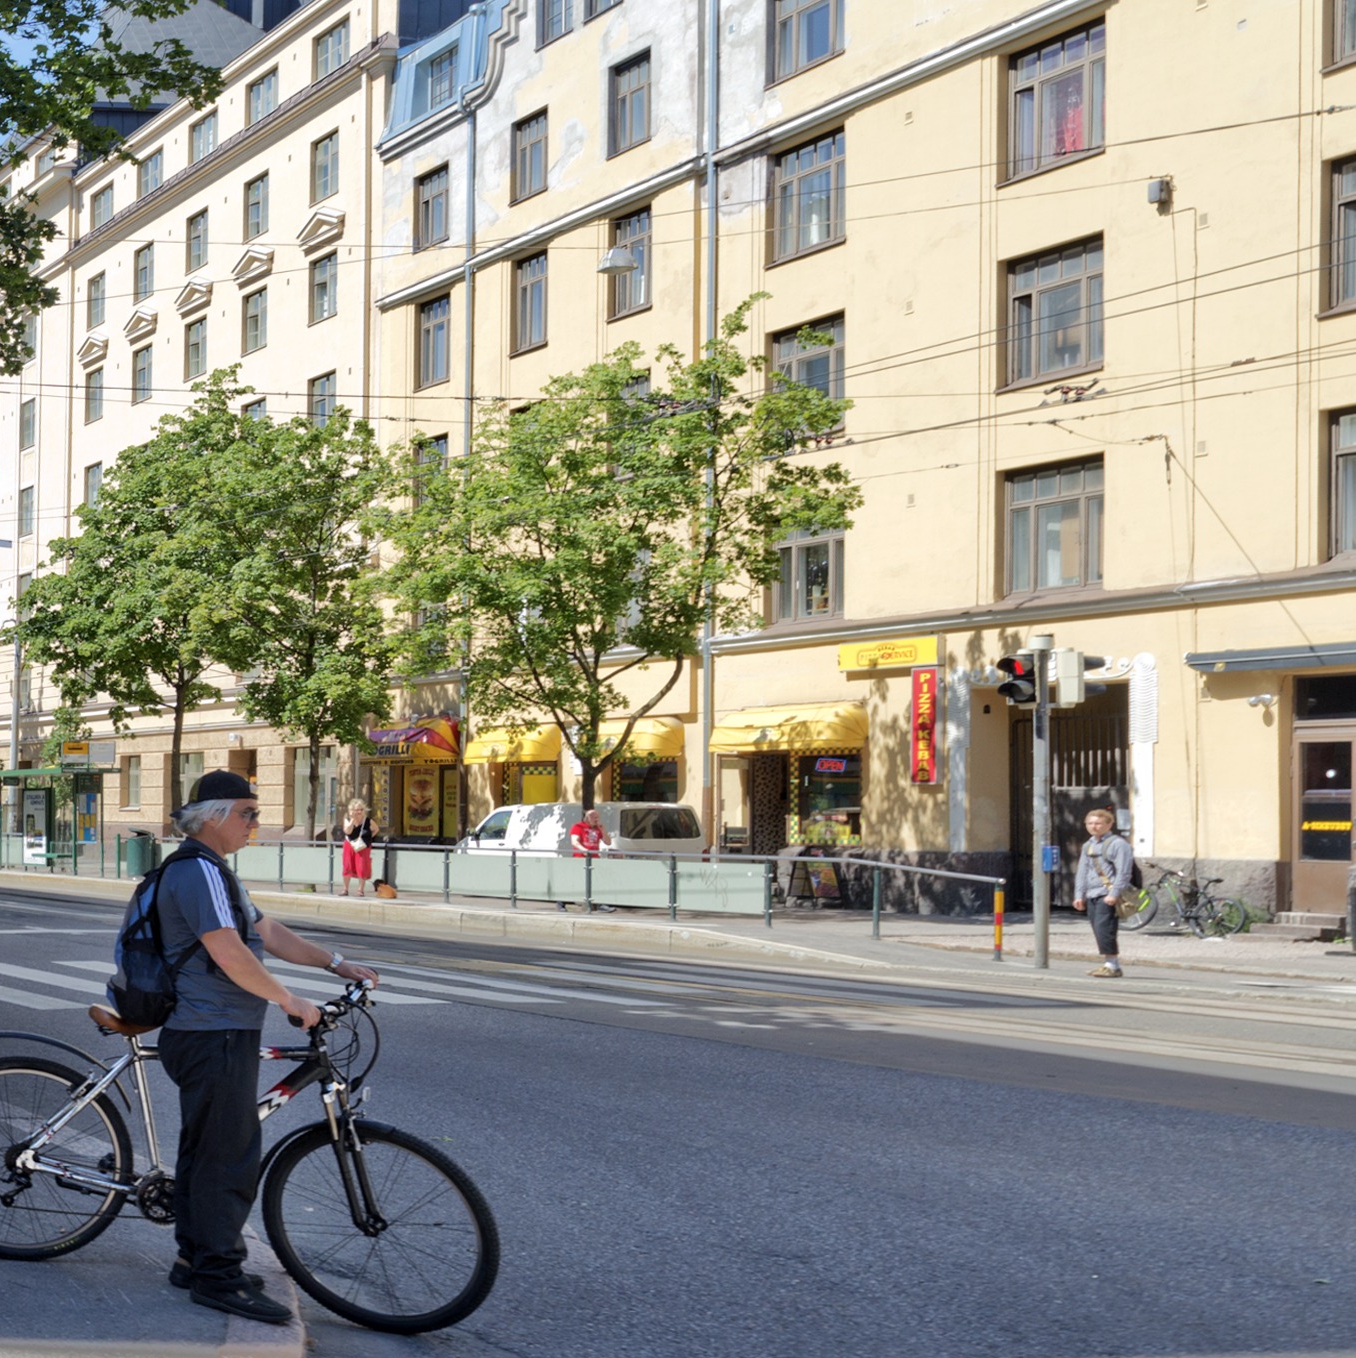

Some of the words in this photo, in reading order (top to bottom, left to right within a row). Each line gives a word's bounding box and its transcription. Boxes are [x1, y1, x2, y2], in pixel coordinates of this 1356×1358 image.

[917, 673, 932, 724] PIZZA
[818, 760, 844, 771] OPEN
[917, 729, 931, 781] KEBAB
